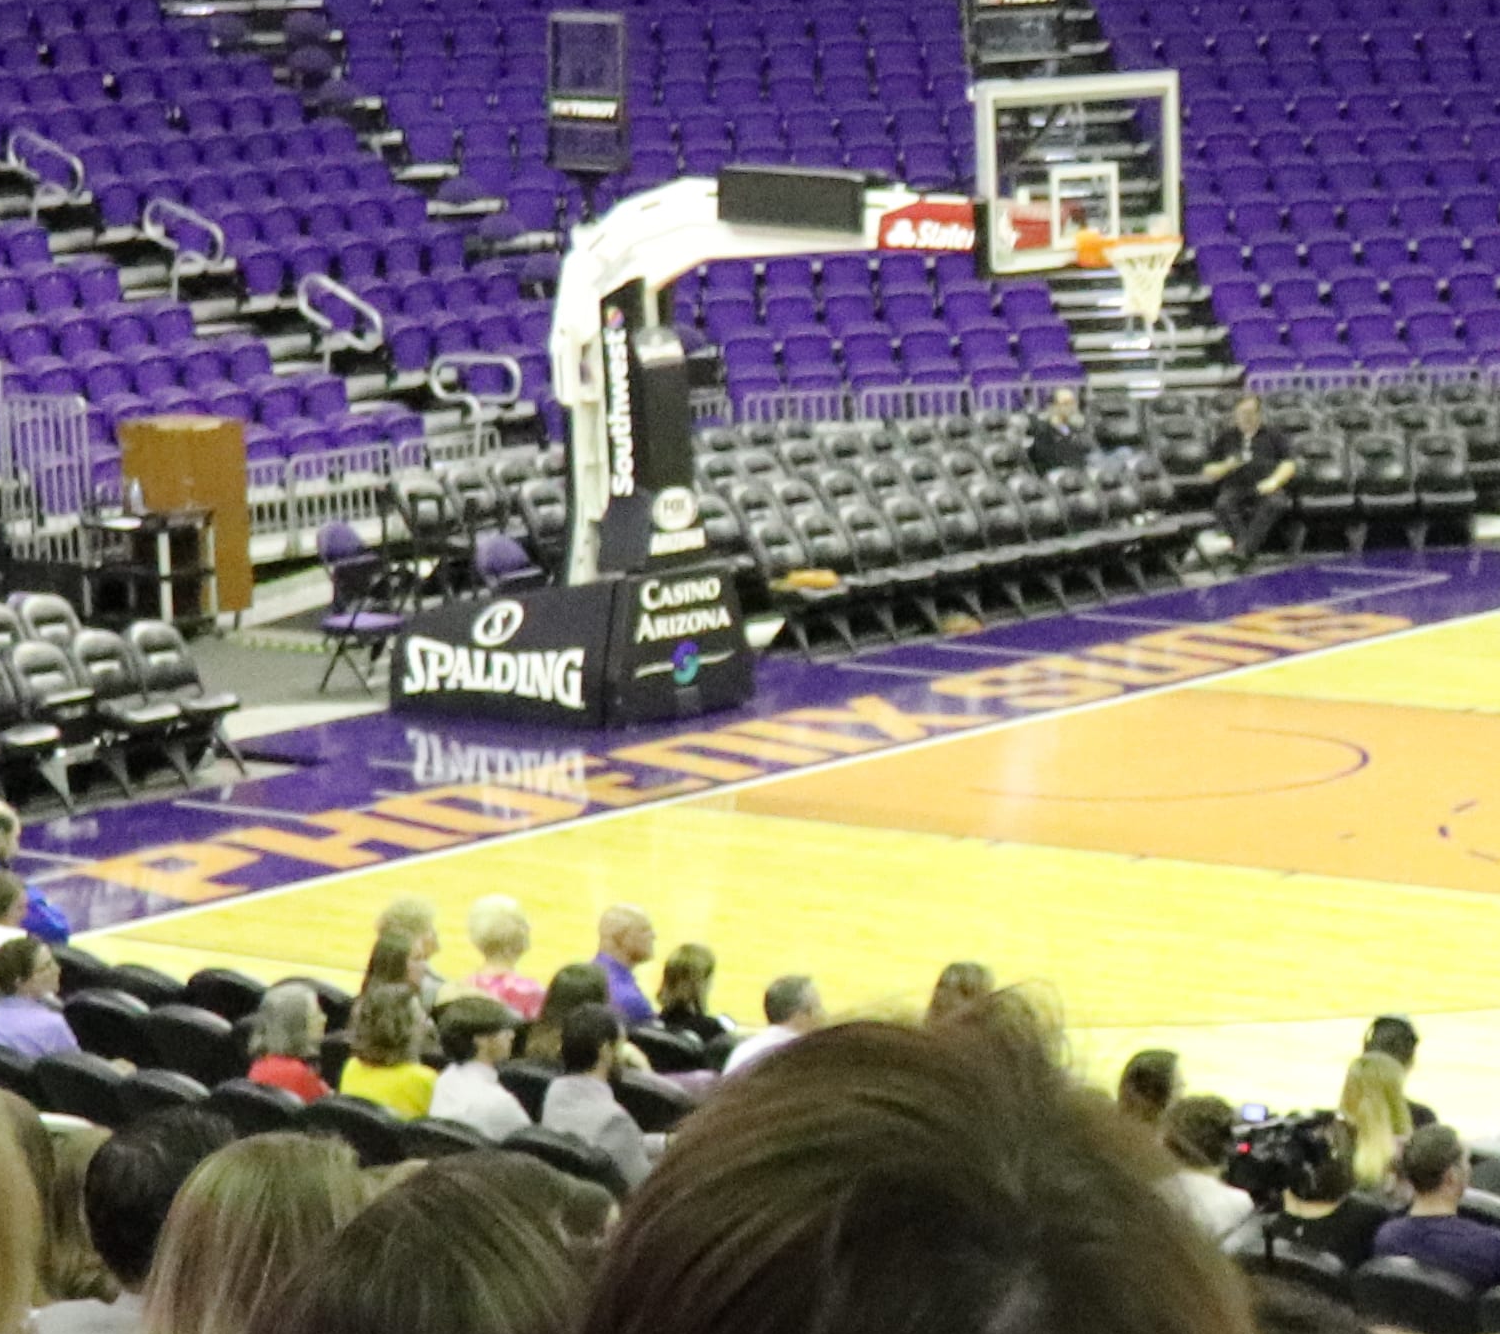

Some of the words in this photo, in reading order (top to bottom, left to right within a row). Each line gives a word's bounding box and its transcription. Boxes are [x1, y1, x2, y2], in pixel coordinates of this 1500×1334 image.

[603, 328, 635, 497] Southwest
[636, 608, 732, 643] ARIZONA
[640, 577, 721, 610] CASINO
[403, 635, 586, 710] SPALDING
[71, 693, 990, 903] PHOENIX
